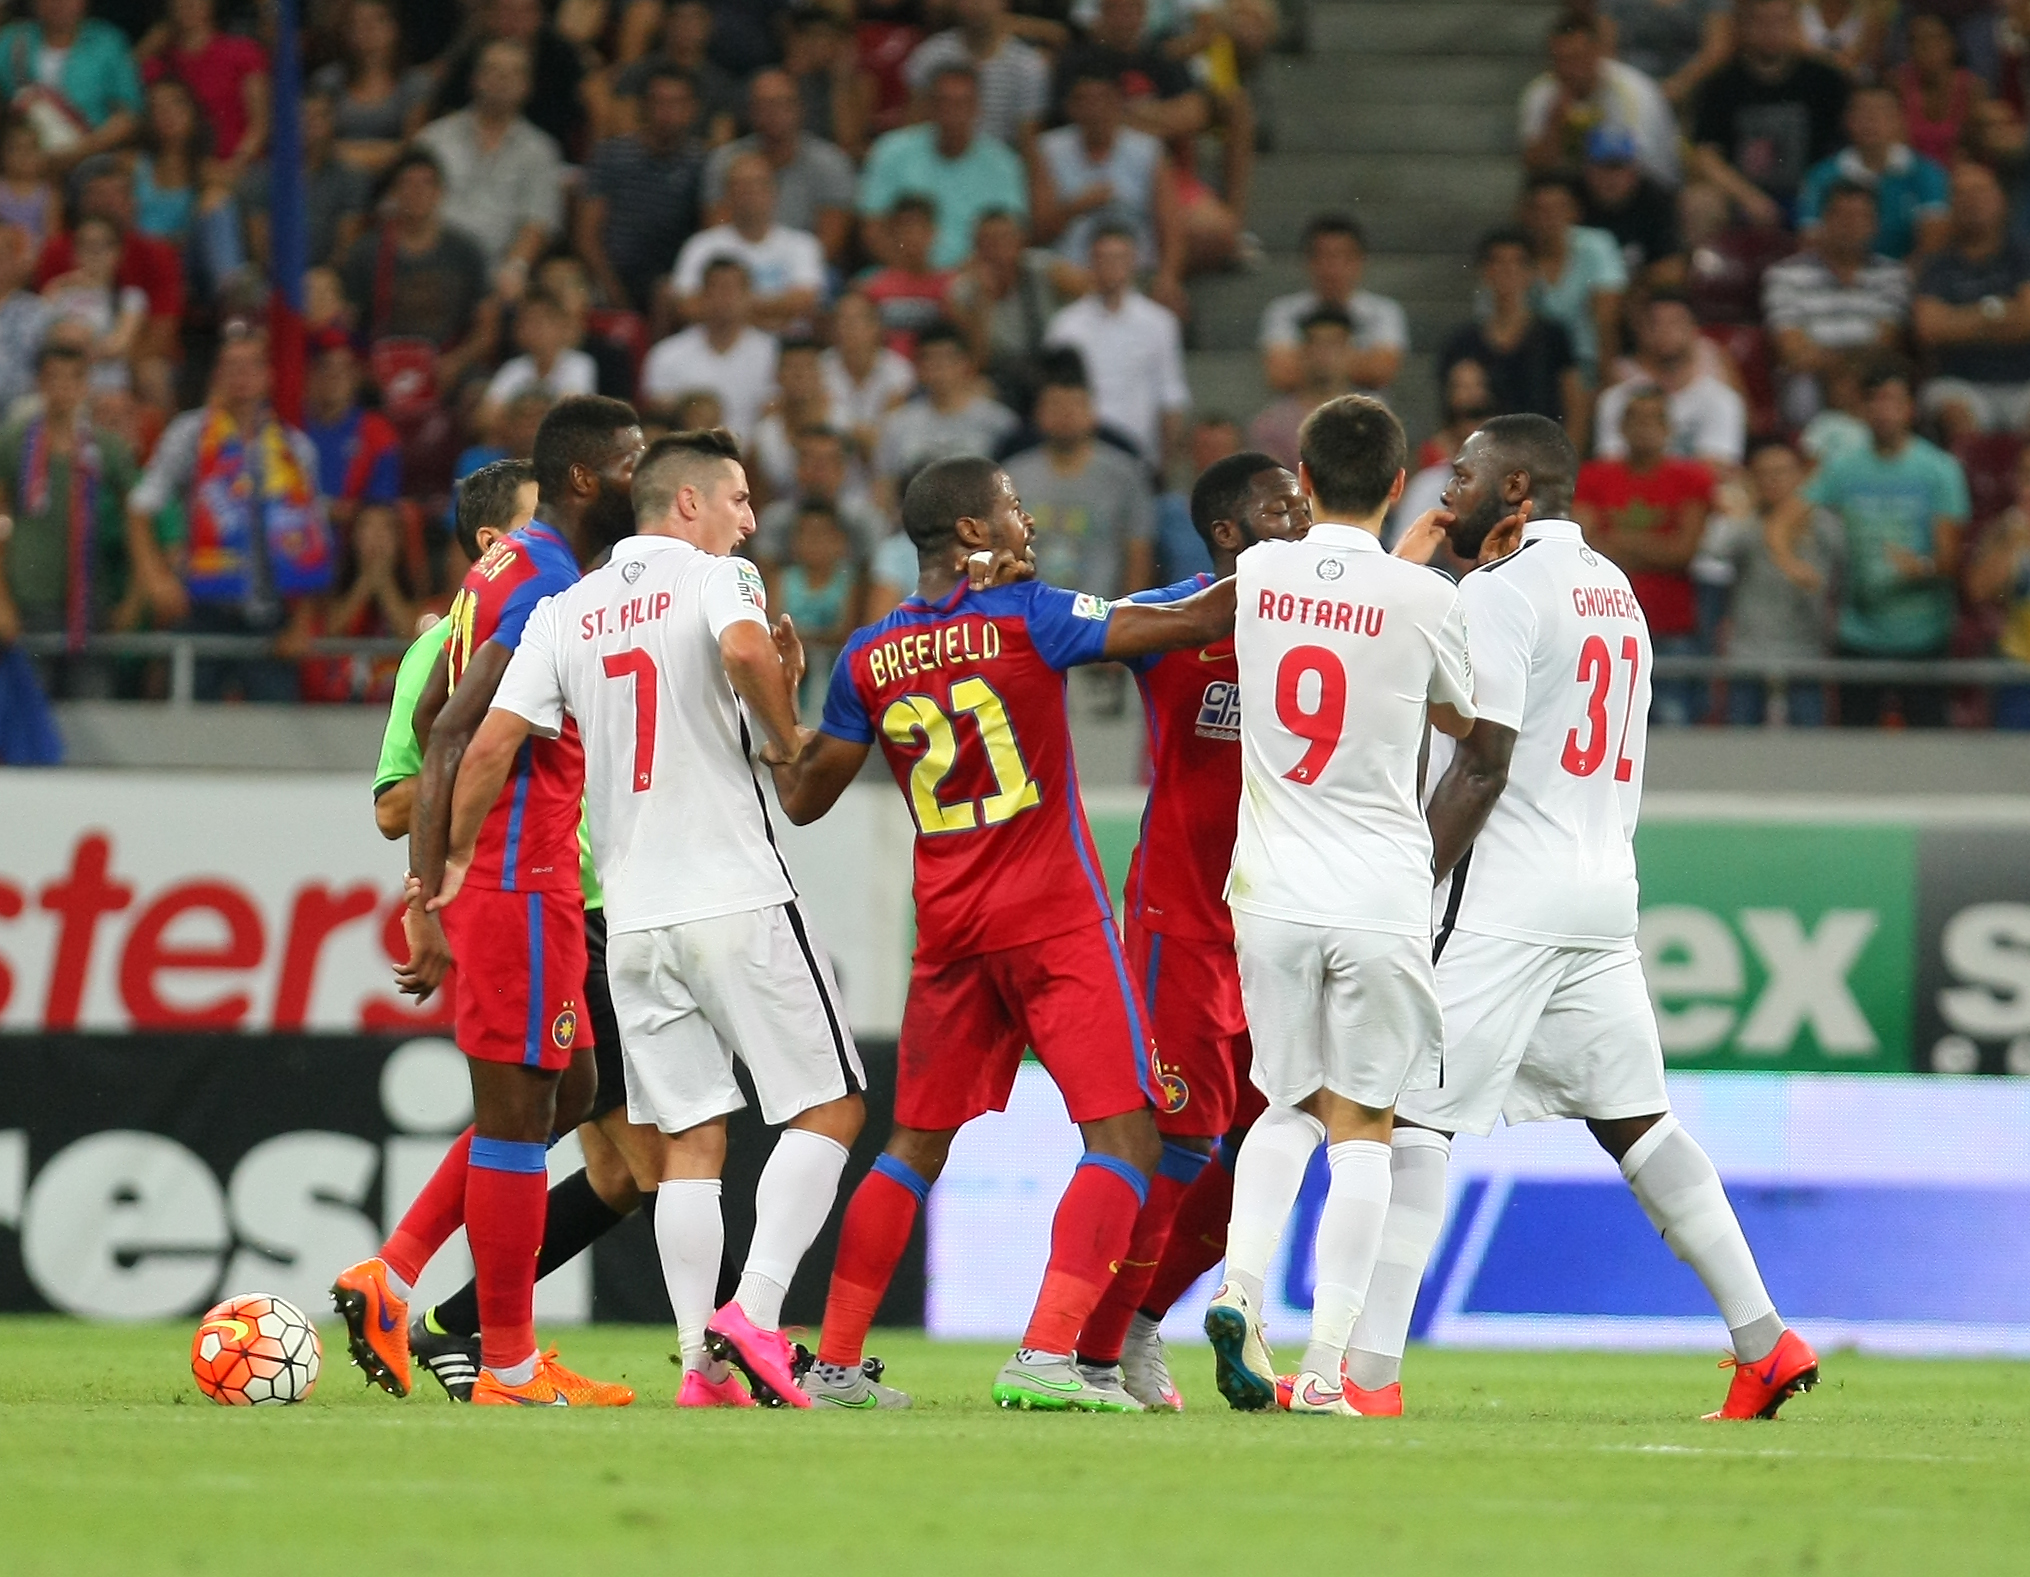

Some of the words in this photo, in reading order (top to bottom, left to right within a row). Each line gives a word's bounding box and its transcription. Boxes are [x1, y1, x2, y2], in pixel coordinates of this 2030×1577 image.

[580, 605, 614, 641] ST.
[620, 591, 672, 633] FILIP
[1258, 588, 1386, 638] ROTARIU
[1572, 586, 1641, 622] GNOHERE
[601, 646, 658, 794] 7
[881, 674, 1042, 838] 21
[1275, 643, 1349, 787] 9
[1560, 634, 1640, 783] 32
